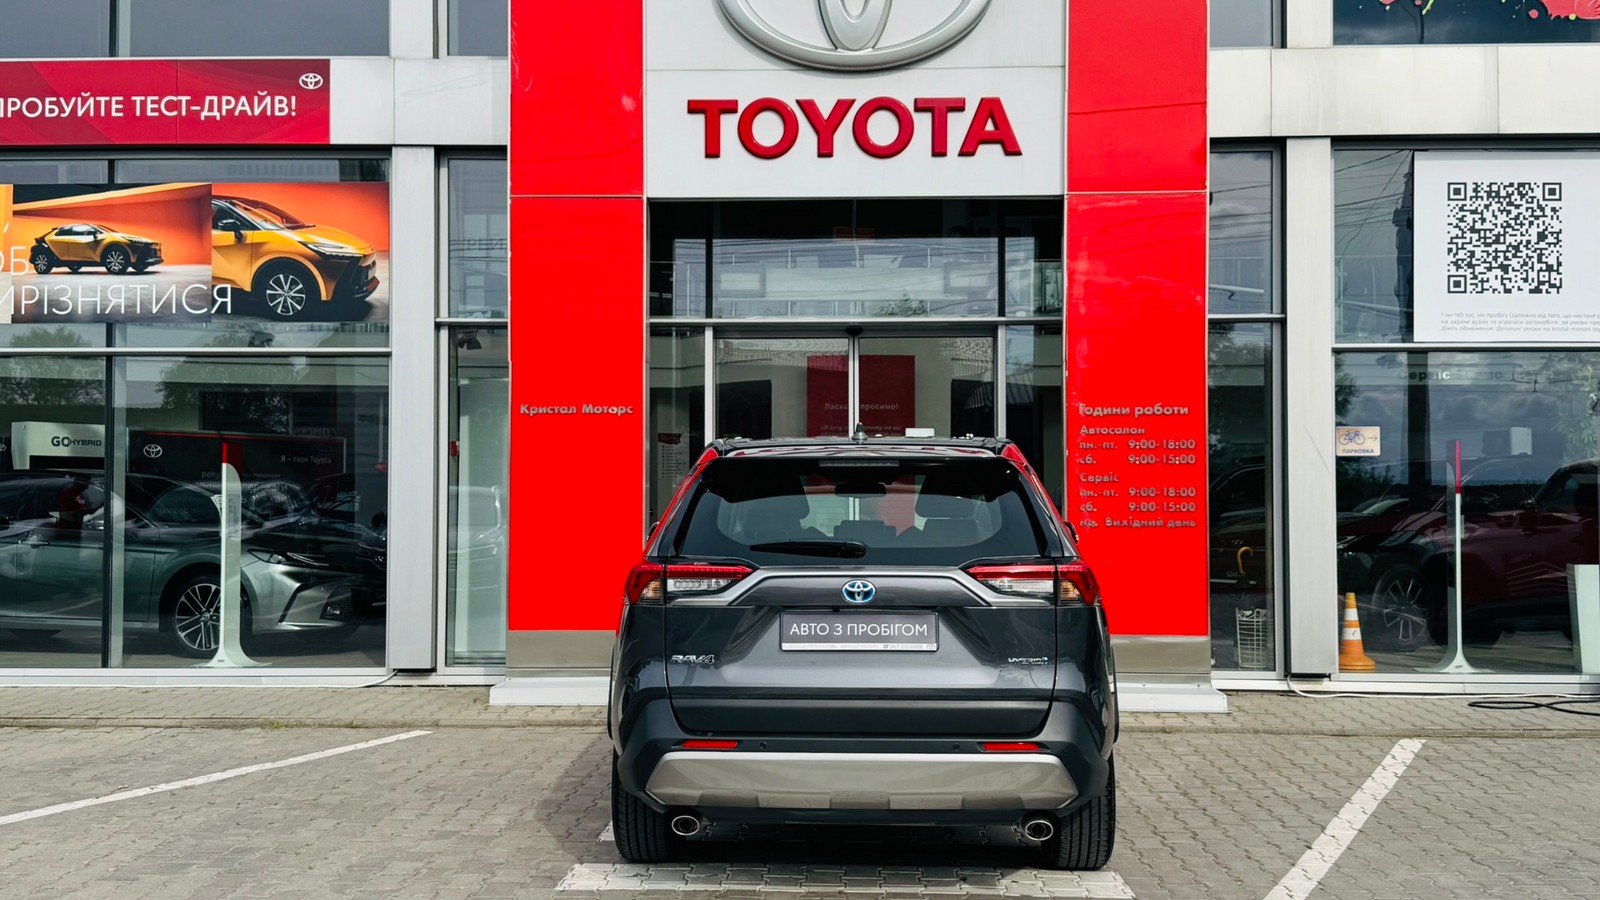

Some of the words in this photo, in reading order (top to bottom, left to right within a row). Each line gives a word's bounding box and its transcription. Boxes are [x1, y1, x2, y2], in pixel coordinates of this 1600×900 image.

[0, 91, 124, 118] РОБУЙТЕ
[131, 91, 297, 120] ТЕСТ-ДРАЙВ!
[686, 95, 1023, 160] TOYOTA
[0, 246, 29, 275] Б
[519, 403, 577, 417] Кристал
[582, 403, 633, 417] Моторс
[824, 402, 848, 410] Ласка
[860, 402, 899, 412] просимо!
[1078, 403, 1130, 417] Години
[1134, 403, 1189, 418] роботи
[1080, 425, 1145, 435] Автосалон
[309, 455, 332, 465] Toyota
[1079, 454, 1097, 464] сб.
[1079, 472, 1119, 485] Сервіс
[1079, 502, 1097, 512] сб.
[1079, 520, 1098, 528] нд.
[1105, 516, 1164, 528] Вихідний
[1167, 519, 1196, 528] день
[789, 623, 830, 636] АВТО
[833, 623, 843, 636] З
[847, 623, 928, 636] ПРОБІГОМ
[670, 654, 715, 665] RAV4
